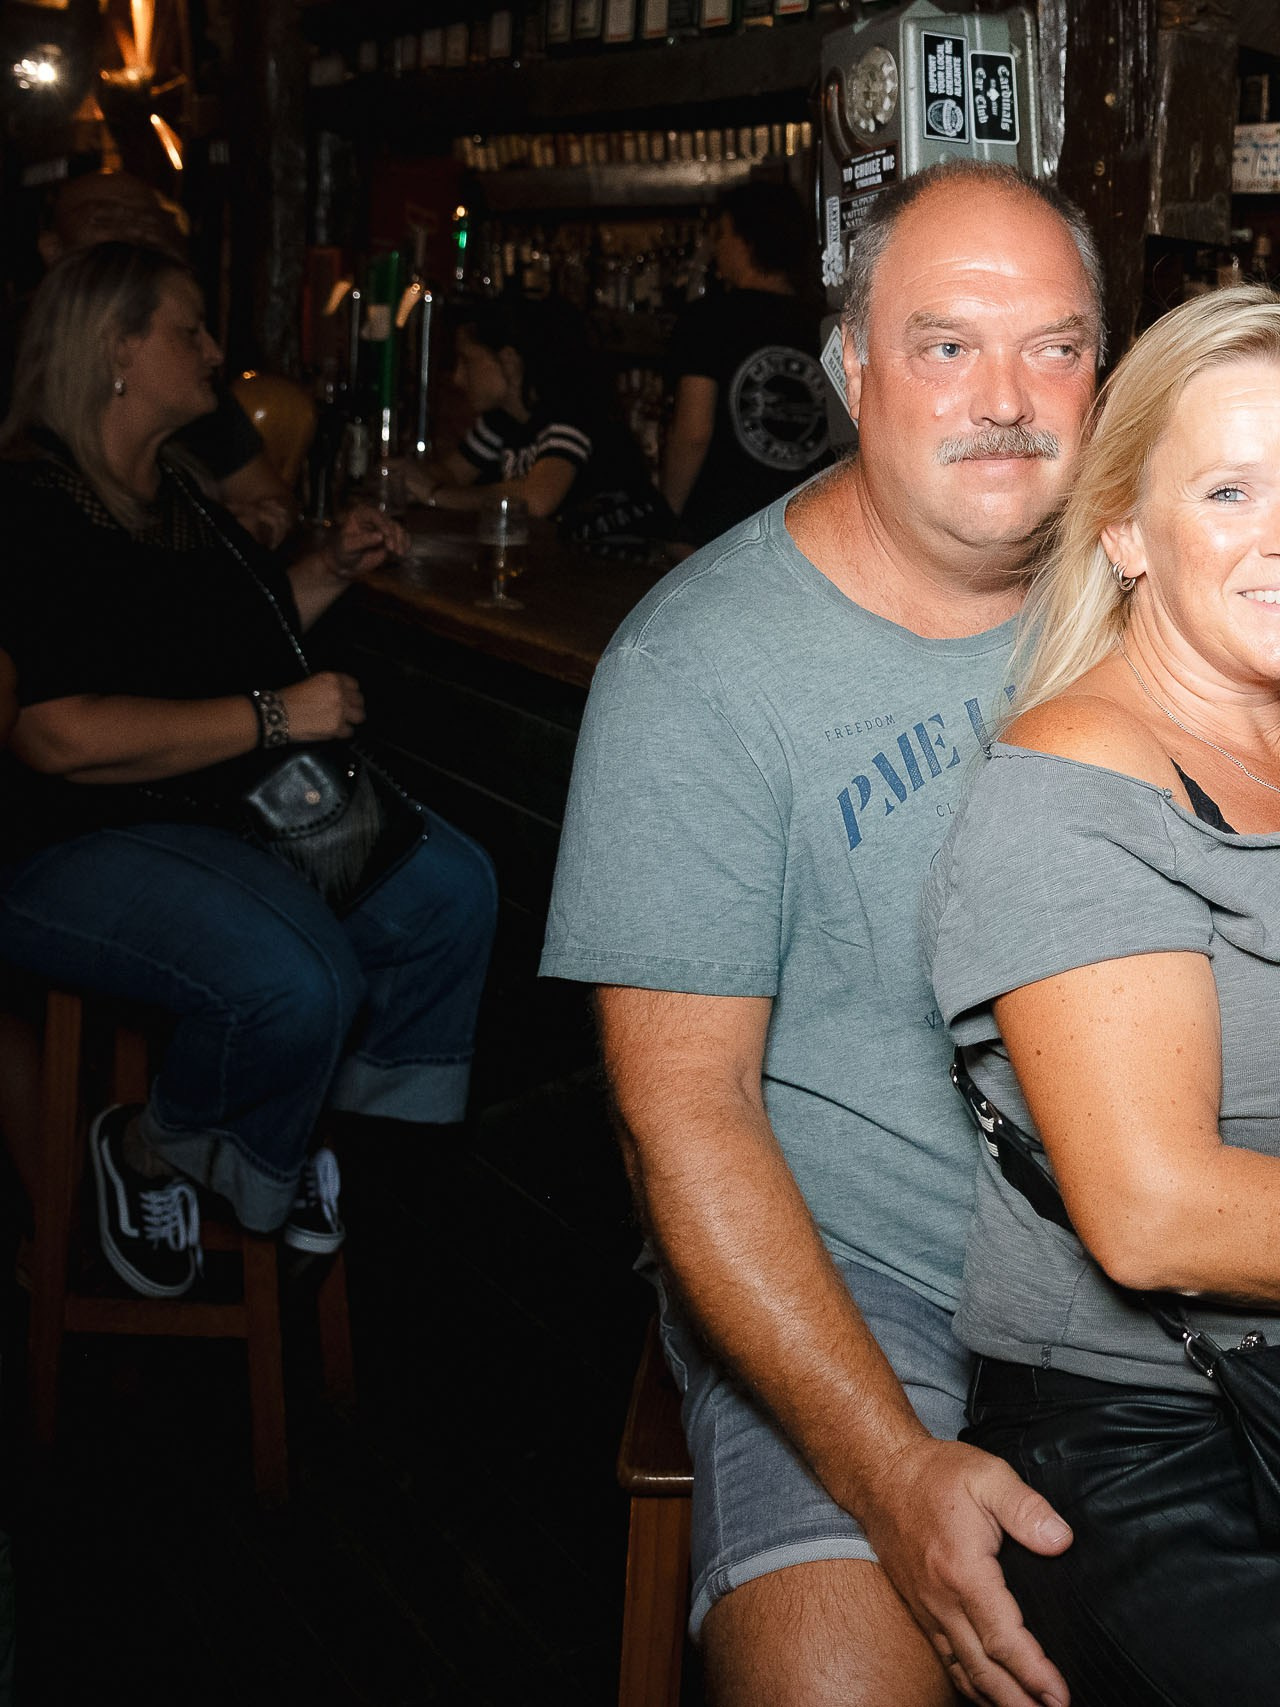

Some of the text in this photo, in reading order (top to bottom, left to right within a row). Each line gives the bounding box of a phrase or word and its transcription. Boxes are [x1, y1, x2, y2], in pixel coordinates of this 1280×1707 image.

[975, 67, 989, 124] Car Club
[998, 65, 1013, 132] Cardinals
[824, 714, 896, 742] FREEDOM
[837, 713, 961, 851] PME
